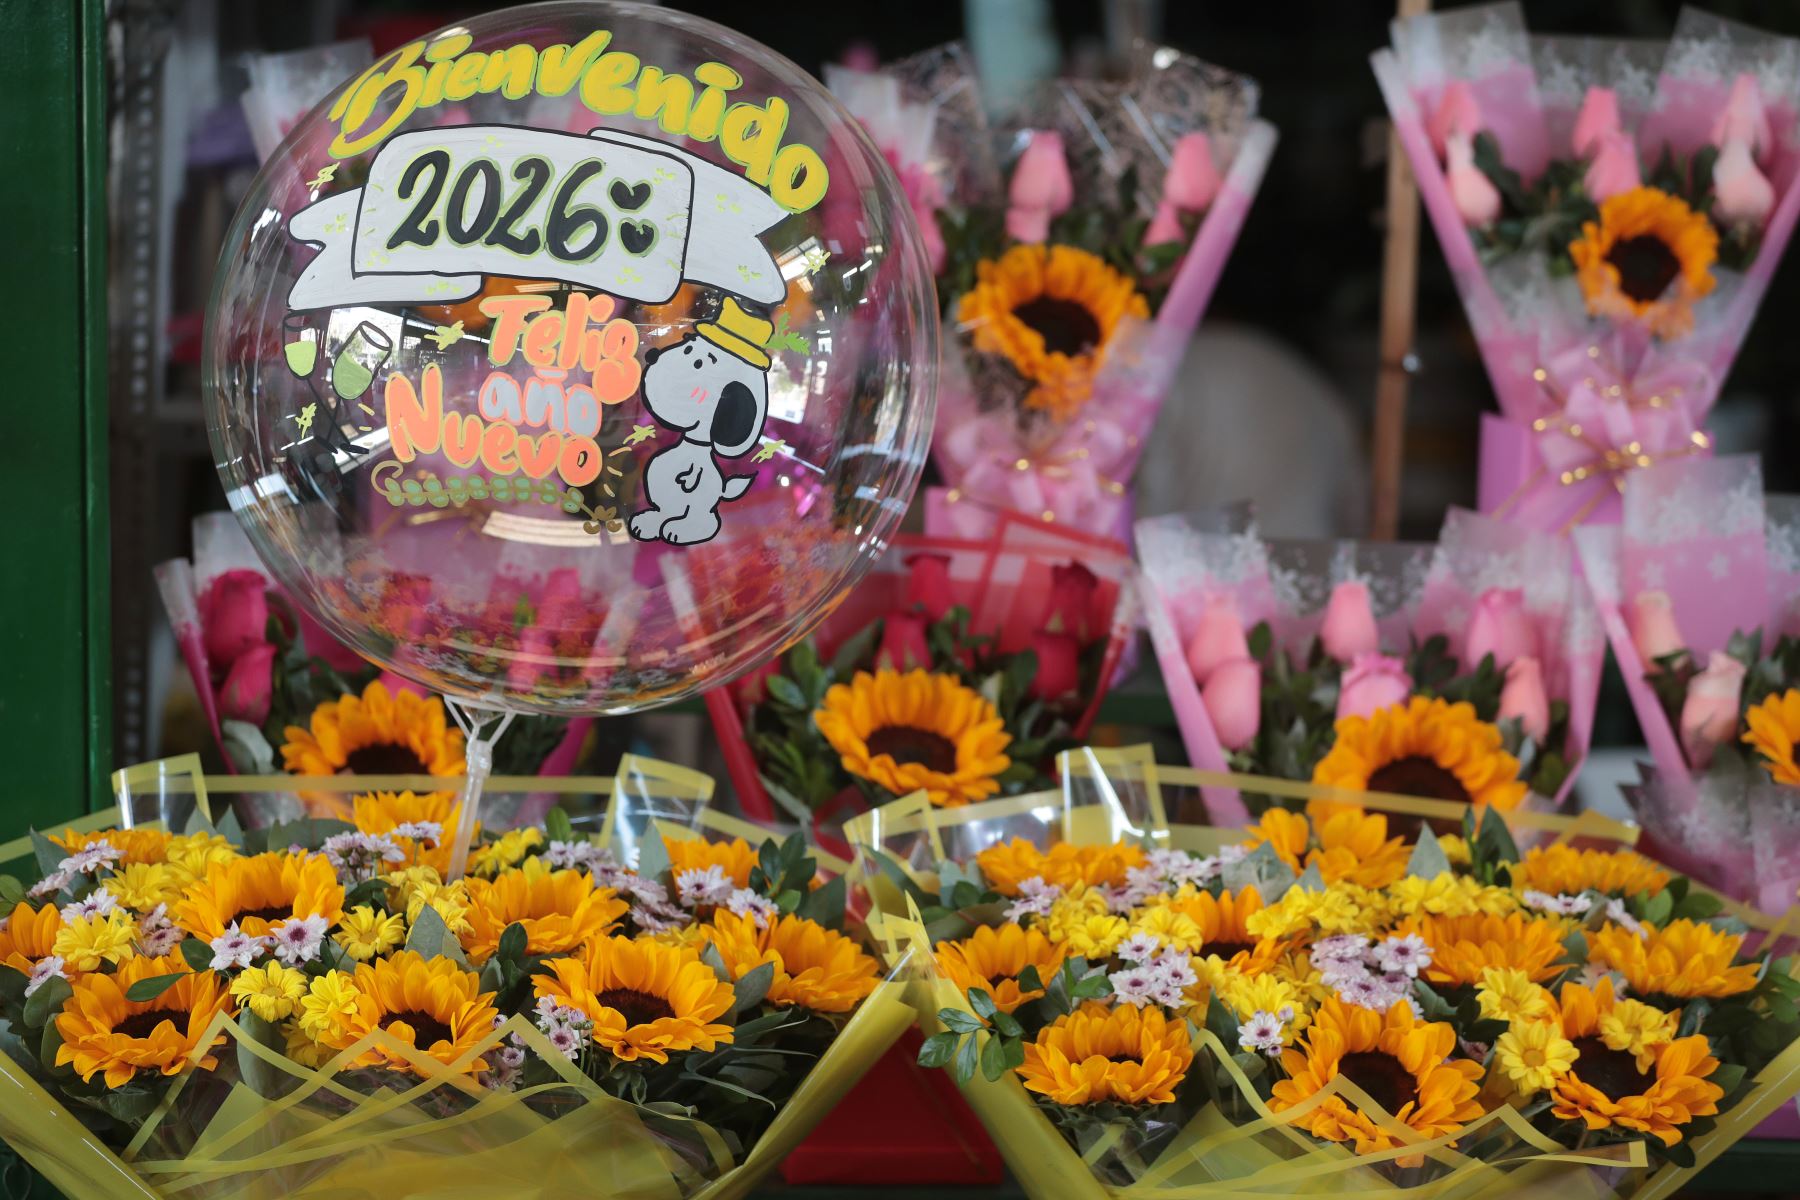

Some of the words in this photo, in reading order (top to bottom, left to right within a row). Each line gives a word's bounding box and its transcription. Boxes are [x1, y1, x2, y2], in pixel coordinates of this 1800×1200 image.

[327, 29, 830, 214] Bienvenido
[385, 146, 610, 264] 2026
[385, 362, 603, 487] Nuevo
[478, 366, 603, 439] año
